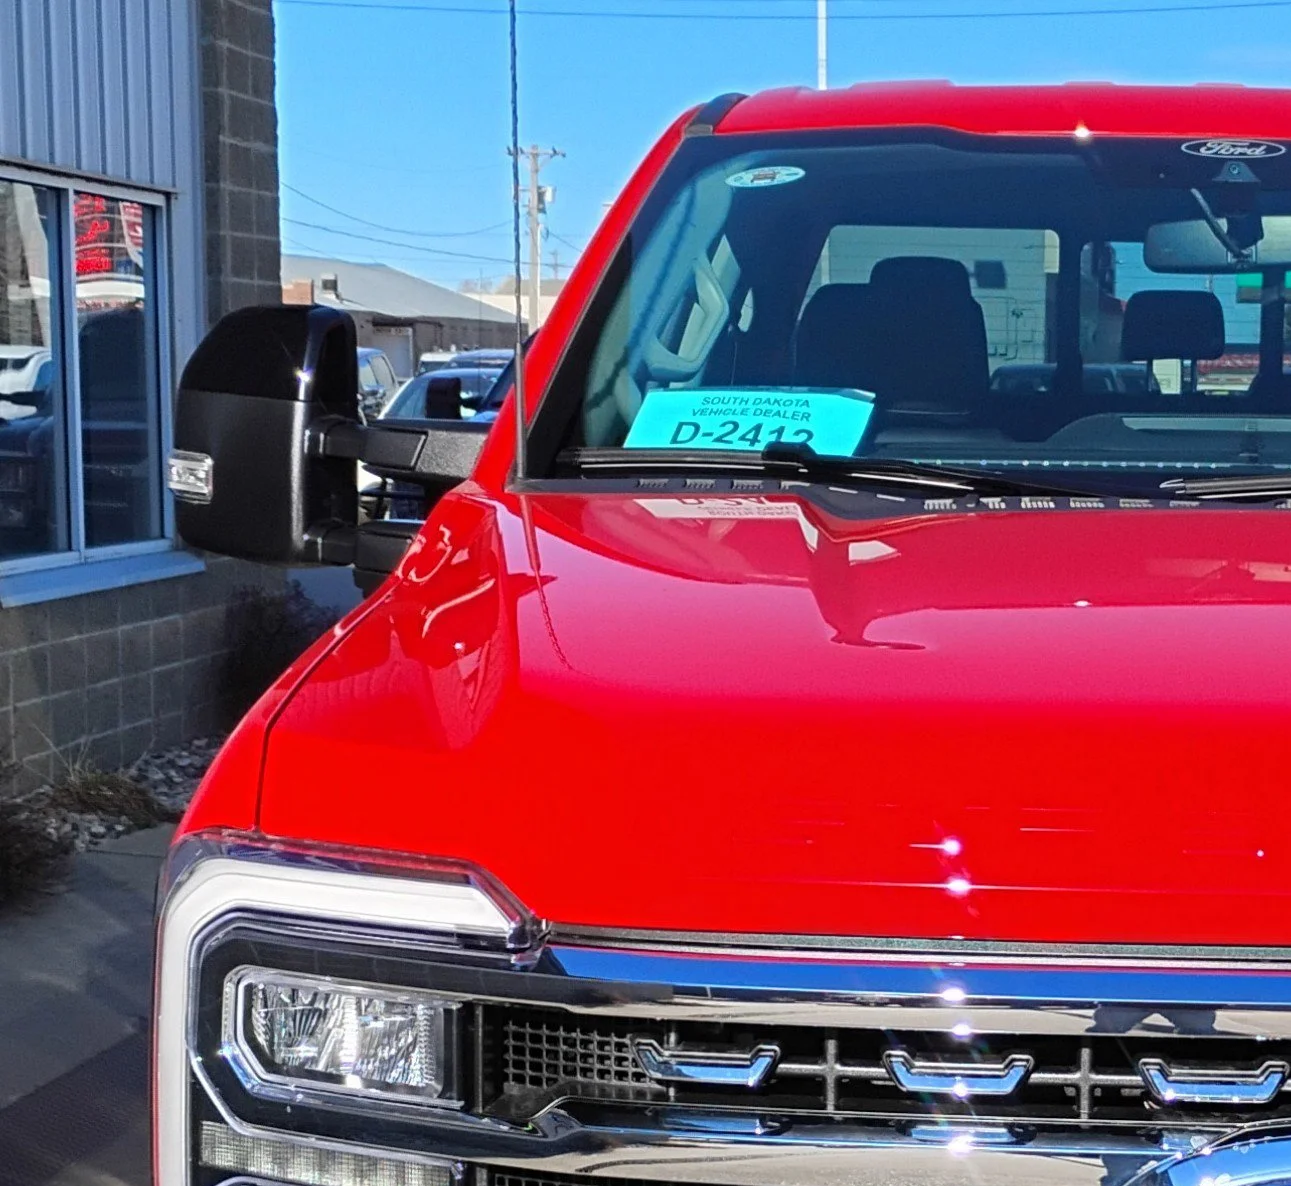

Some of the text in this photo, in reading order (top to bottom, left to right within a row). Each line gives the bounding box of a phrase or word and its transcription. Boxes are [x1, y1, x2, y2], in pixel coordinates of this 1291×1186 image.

[1199, 141, 1267, 156] Ford
[701, 396, 811, 409] SOUTH DAKOTA
[692, 407, 812, 422] VEHICLE DEALER
